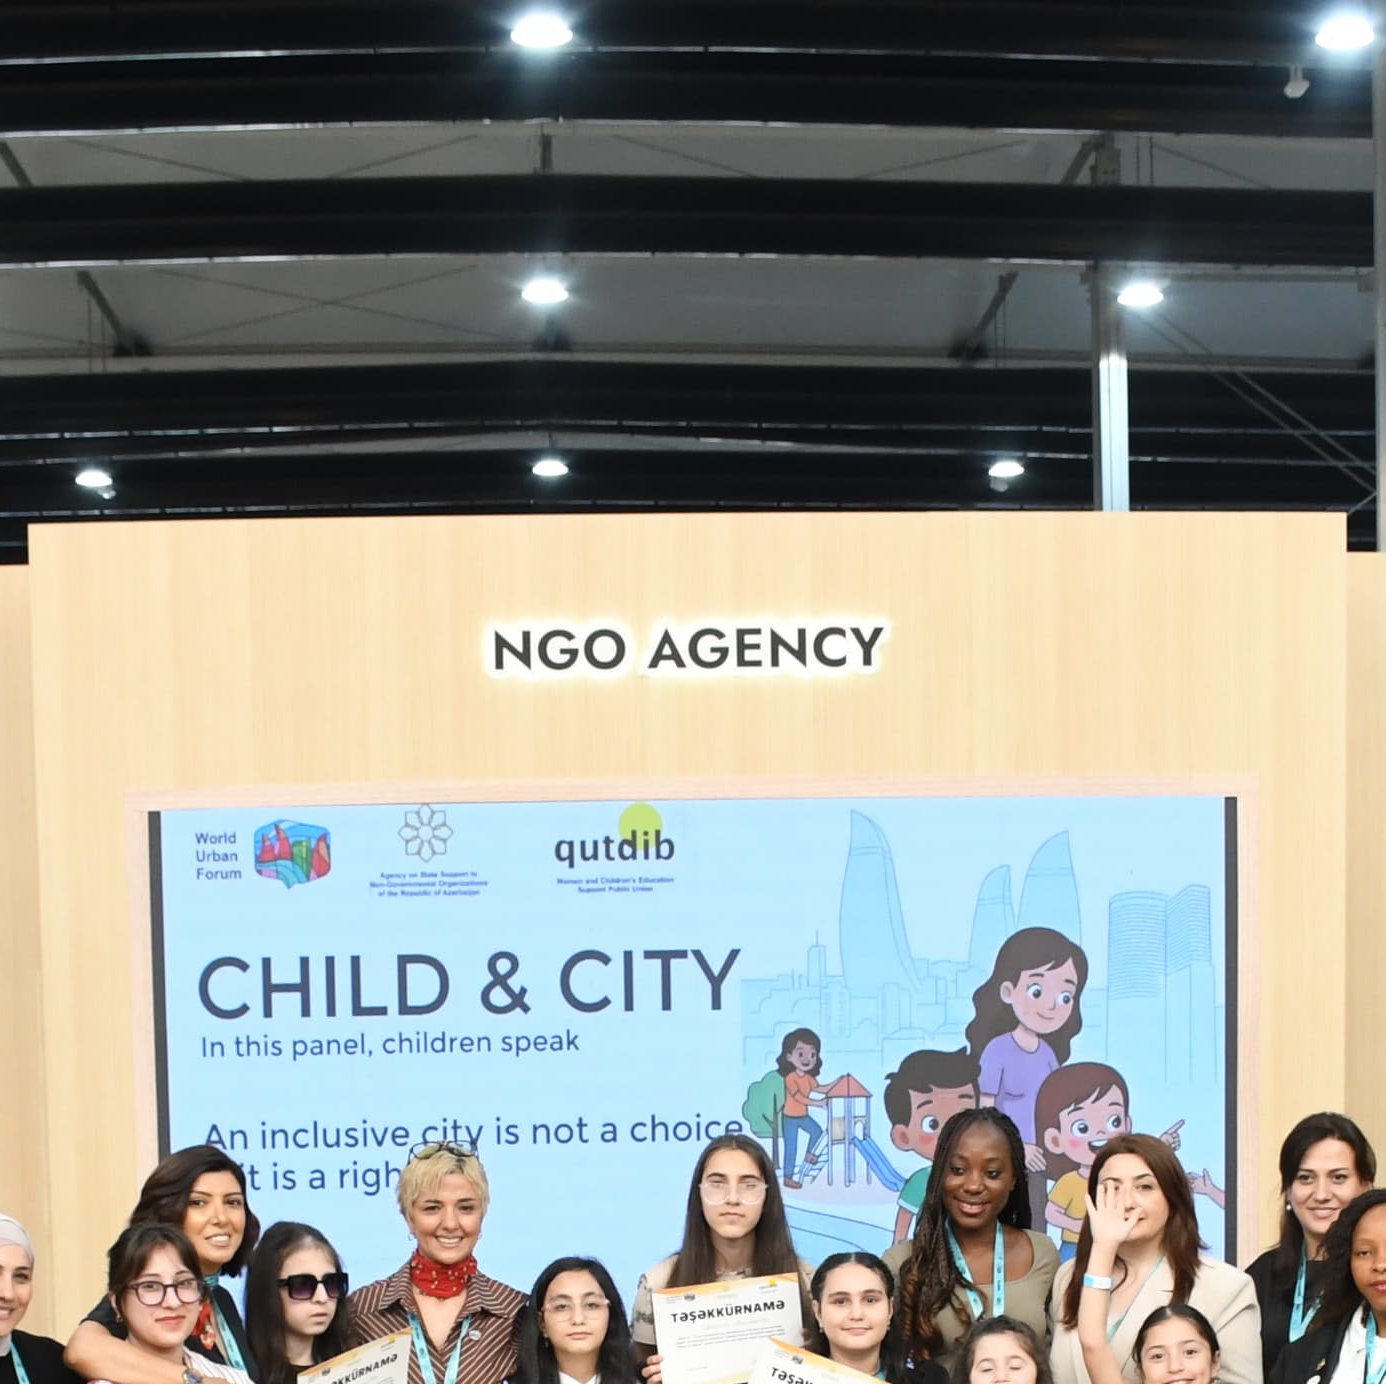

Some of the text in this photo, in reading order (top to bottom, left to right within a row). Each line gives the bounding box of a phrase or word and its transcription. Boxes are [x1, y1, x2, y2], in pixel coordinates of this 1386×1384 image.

[494, 626, 884, 671] NGO AGENCY
[195, 831, 237, 844] World
[195, 849, 239, 862] Urban
[554, 829, 675, 869] qutdib
[196, 867, 242, 881] Forum
[198, 948, 742, 1020] CHILD & CITY
[201, 1028, 580, 1062] In this panel, children speak
[204, 1123, 249, 1151] An
[260, 1119, 410, 1150] inclusive
[421, 1117, 484, 1152] city
[495, 1116, 520, 1145] is
[532, 1116, 590, 1145] not
[600, 1122, 618, 1144] a
[272, 1161, 297, 1191] is
[308, 1168, 326, 1190] a
[339, 1159, 401, 1197] righ
